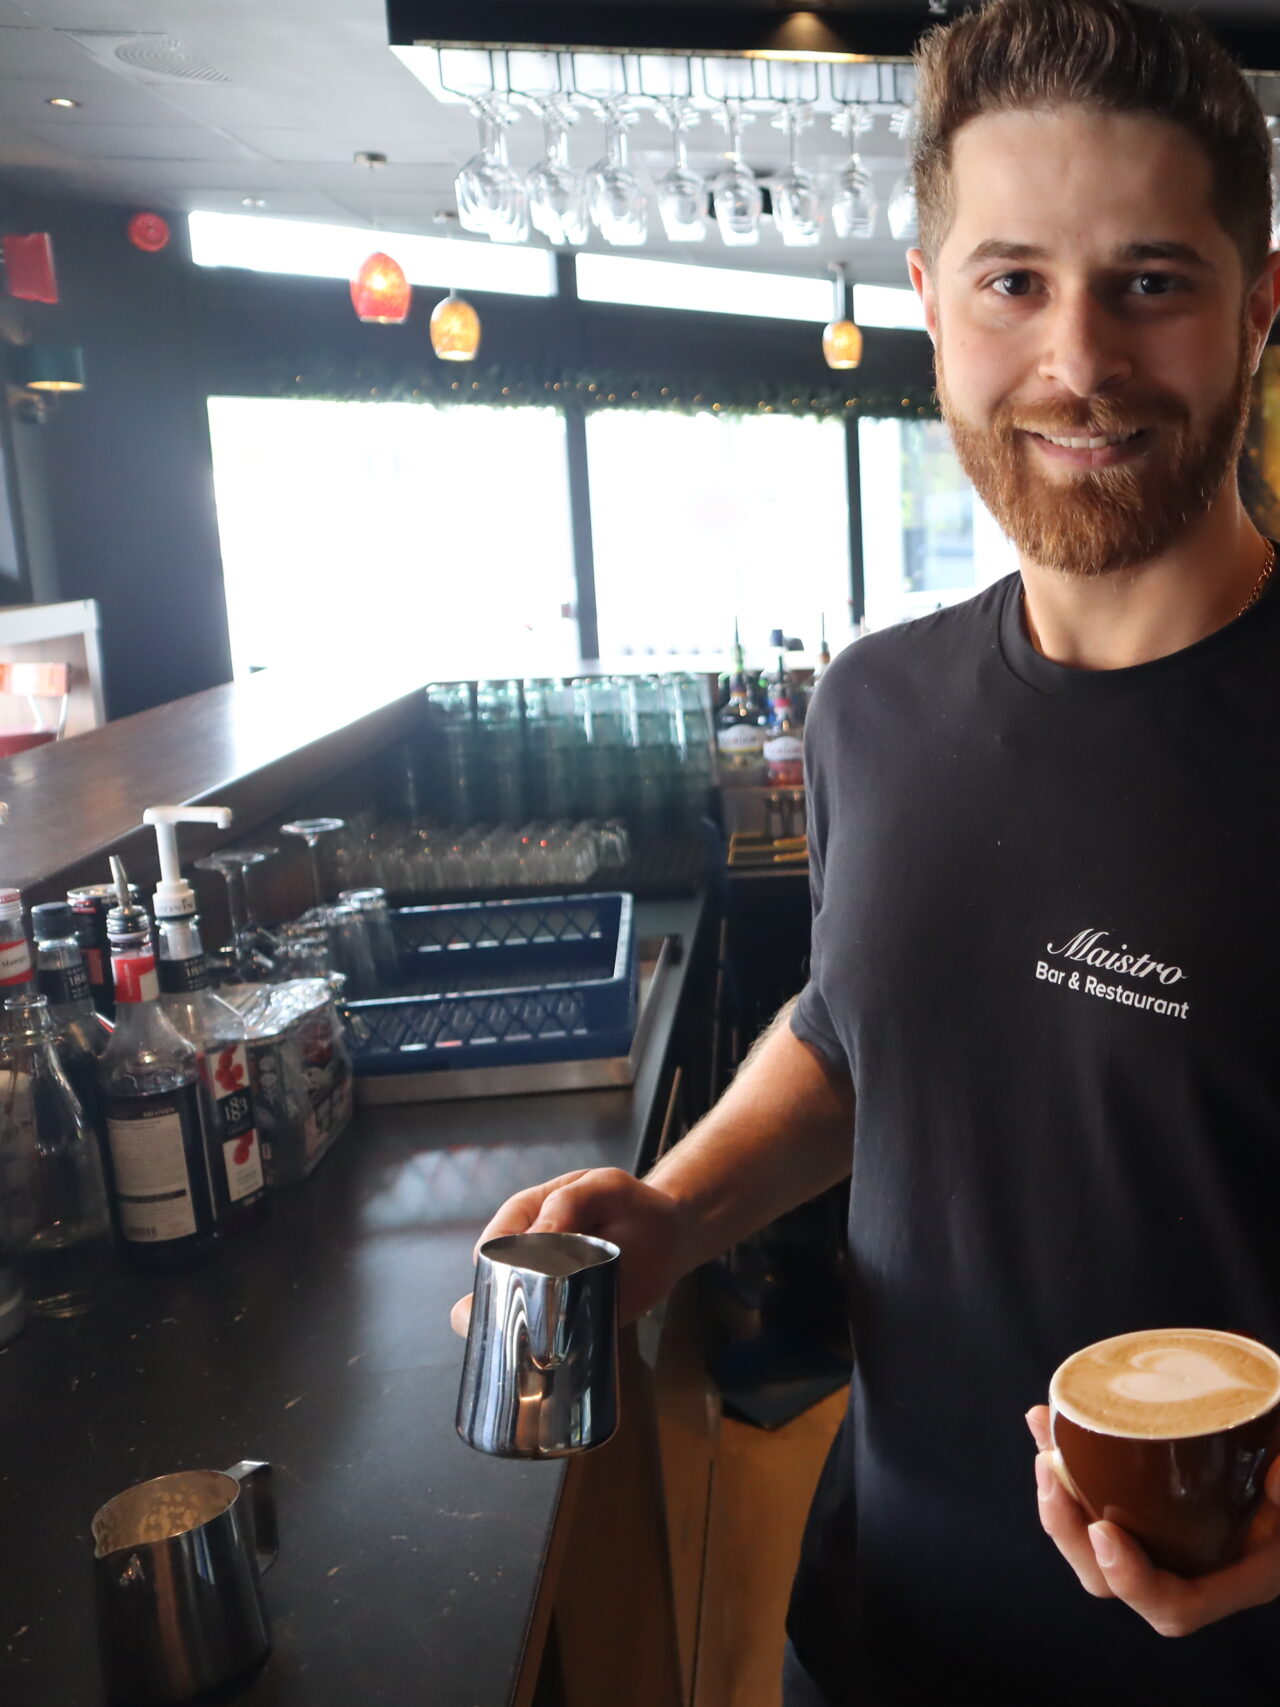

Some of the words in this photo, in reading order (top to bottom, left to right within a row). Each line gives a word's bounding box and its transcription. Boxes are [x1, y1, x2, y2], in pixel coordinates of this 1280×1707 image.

[1047, 928, 1189, 985] Maistro
[1035, 960, 1065, 985] Bar
[1068, 971, 1080, 991] &
[1084, 975, 1190, 1020] Restaurant
